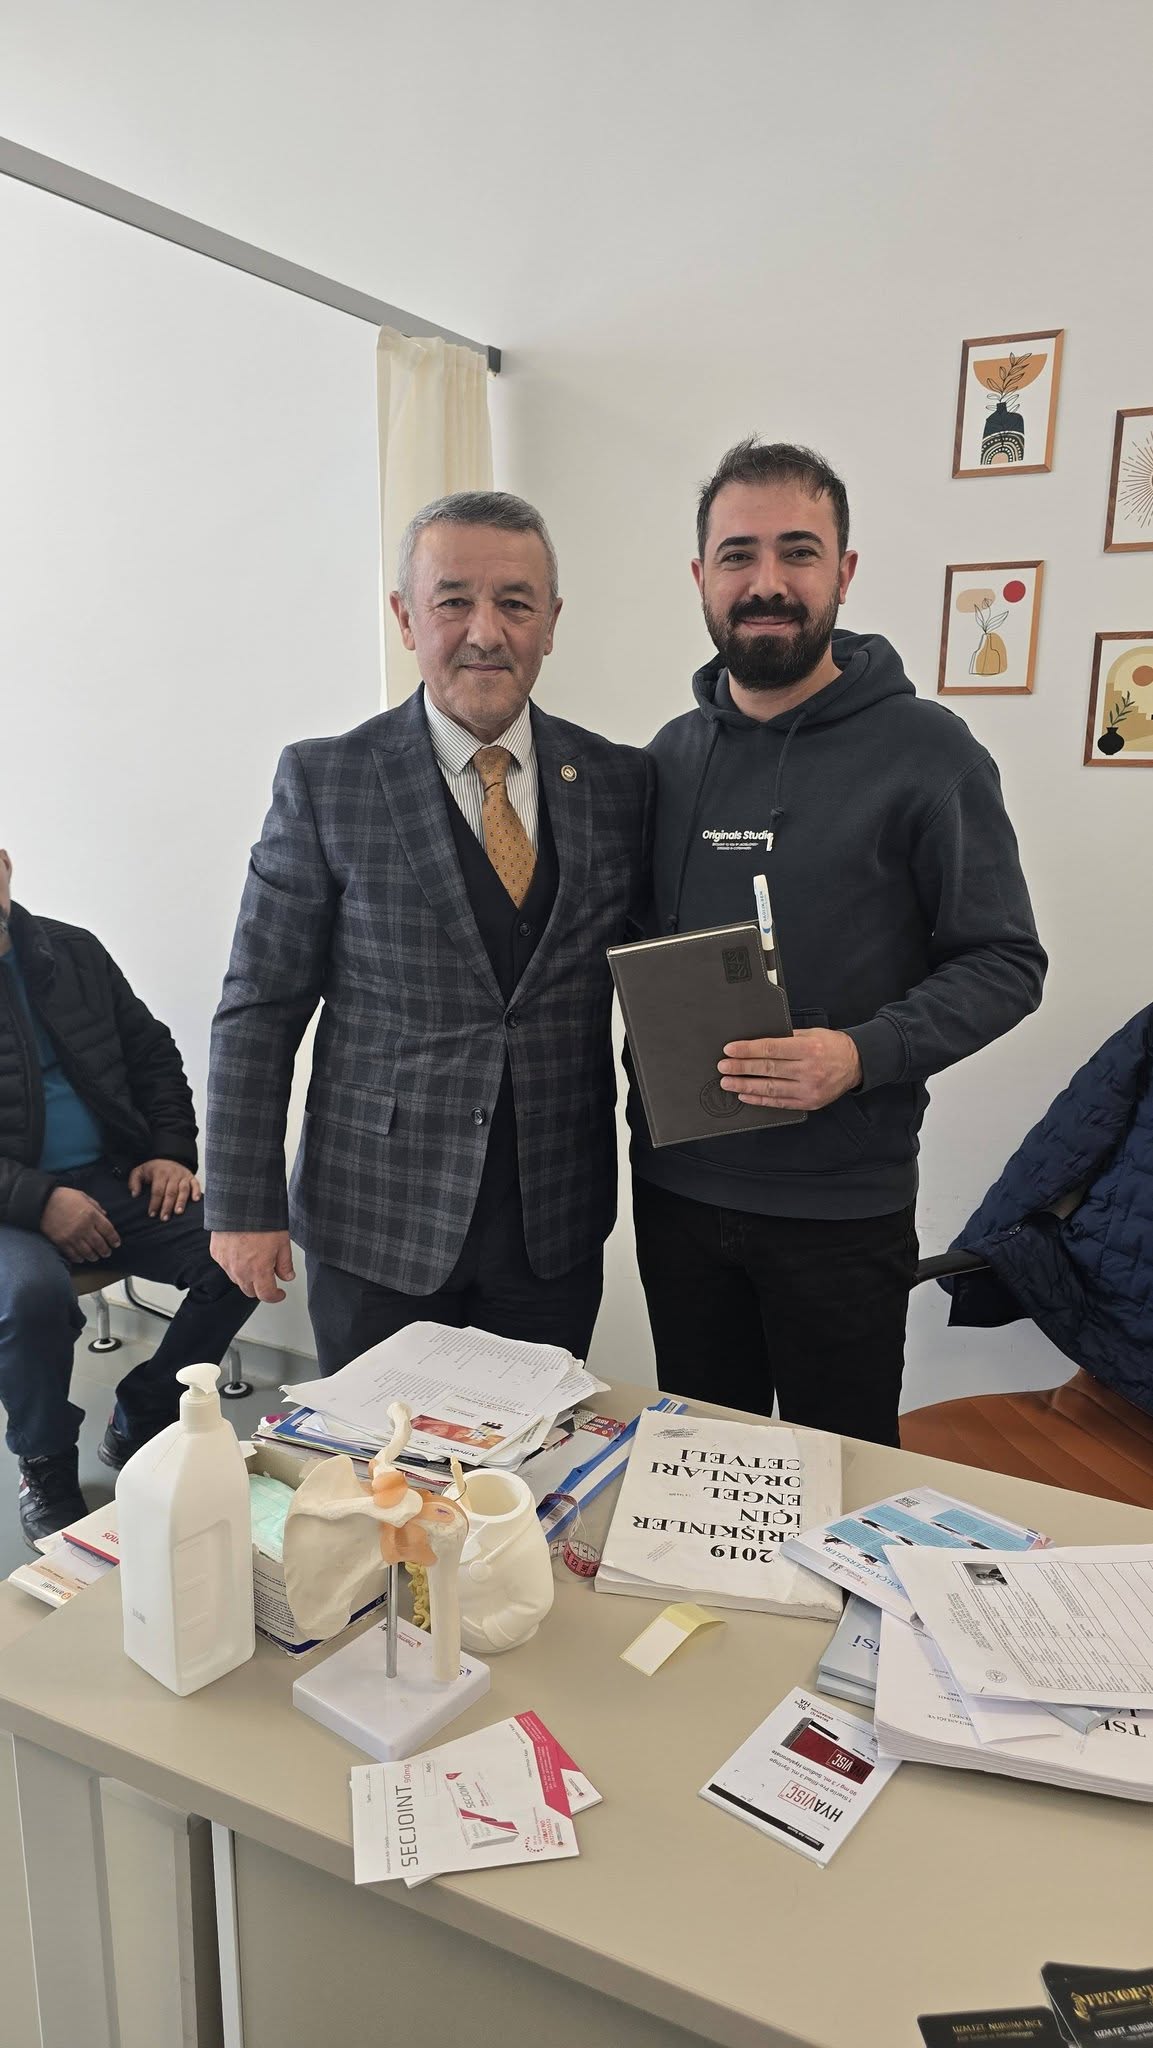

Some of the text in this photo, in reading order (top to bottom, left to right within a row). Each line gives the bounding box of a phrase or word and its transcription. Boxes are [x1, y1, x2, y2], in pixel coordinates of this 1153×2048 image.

[702, 829, 742, 843] Originals
[680, 1448, 800, 1470] CETVELİ
[650, 1462, 800, 1488] ORANLARI
[702, 1486, 800, 1506] ENGEL
[738, 1508, 800, 1528] İÇİN
[102, 1532, 120, 1545] nos
[710, 1544, 774, 1564] 2019
[769, 1757, 790, 1772] Syringe
[772, 1749, 802, 1768] Hyaluronate
[802, 1766, 822, 1780] Sodium
[456, 1782, 476, 1809] SECJOINT
[786, 1785, 844, 1822] HYAVISC
[829, 1789, 849, 1800] Sterile
[395, 1764, 418, 1867] SECJOINT 90mg
